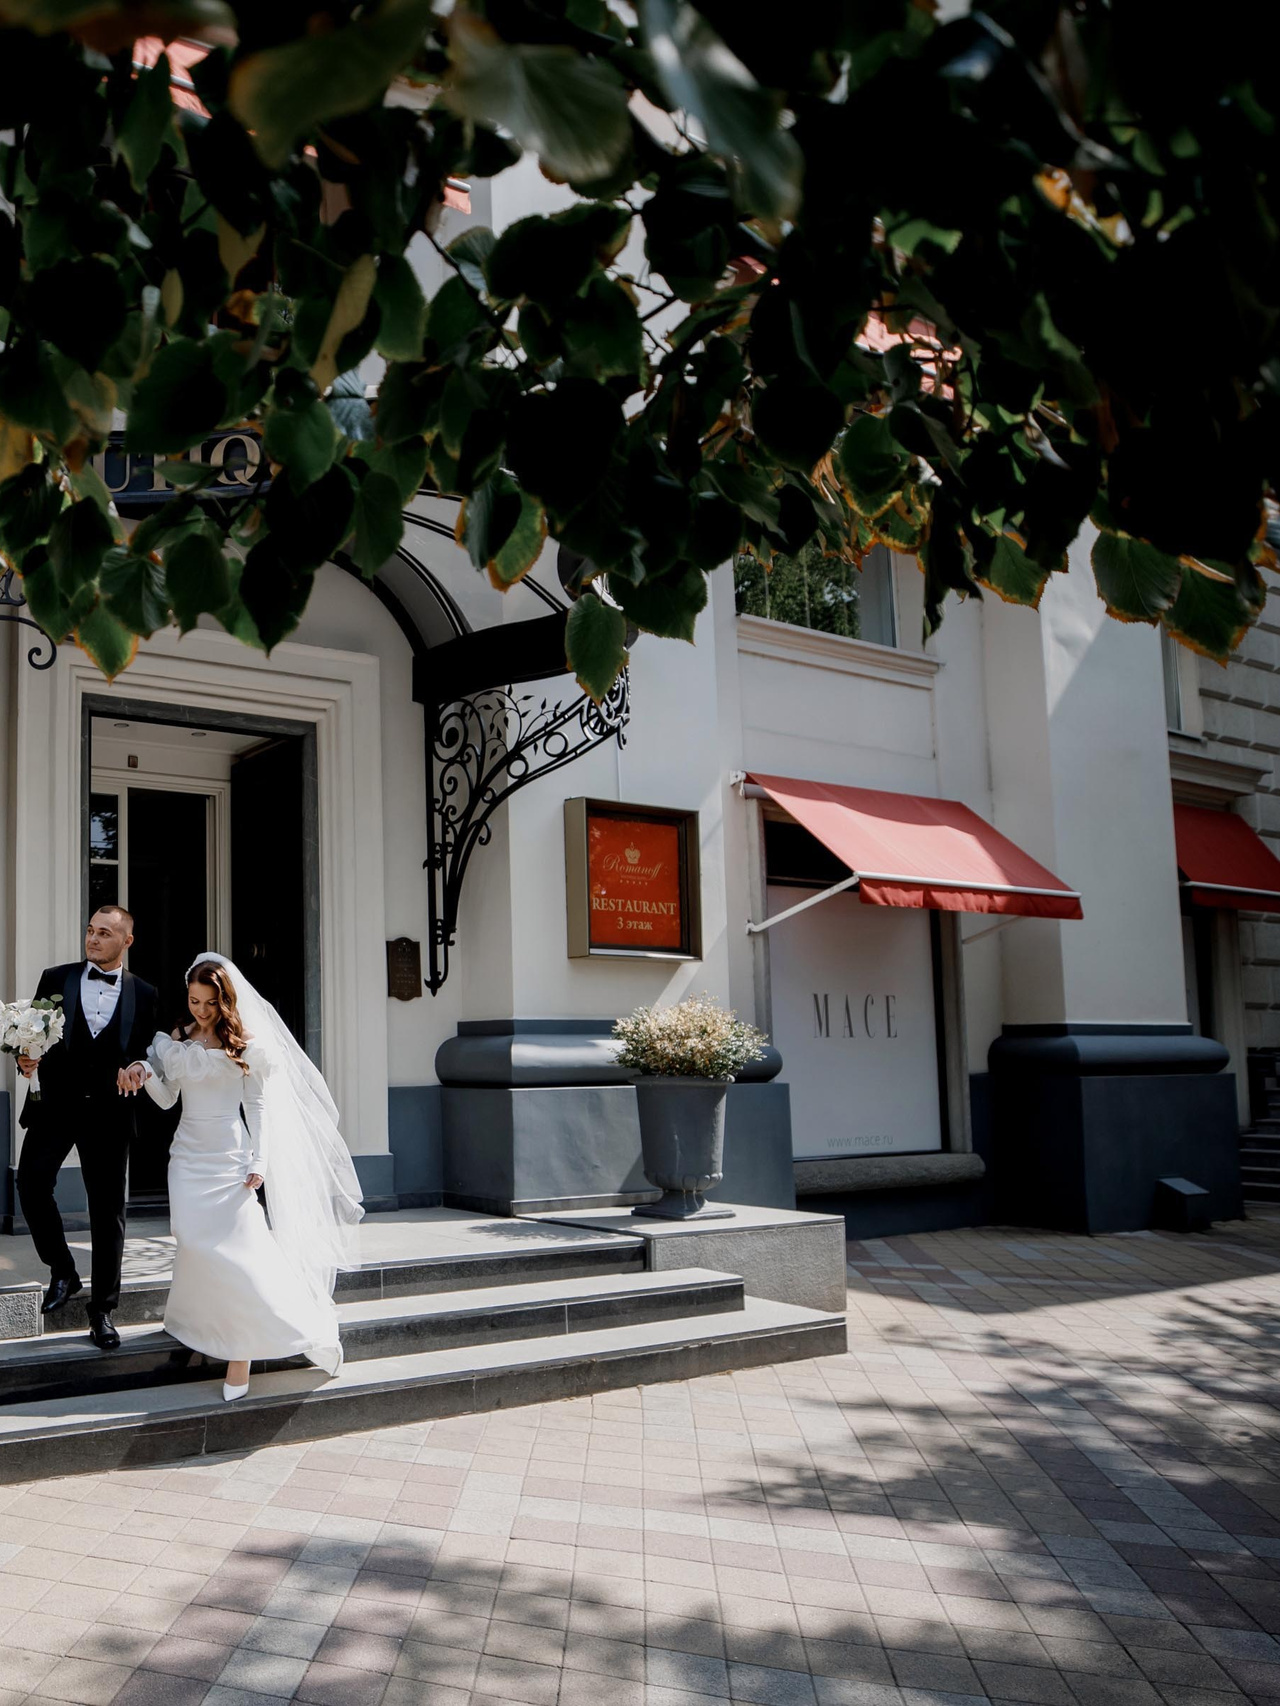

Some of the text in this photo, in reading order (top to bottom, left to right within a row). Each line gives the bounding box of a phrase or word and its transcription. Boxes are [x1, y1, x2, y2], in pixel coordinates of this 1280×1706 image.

[603, 854, 663, 880] Romanoff
[592, 898, 676, 915] RESTAURANT
[617, 917, 652, 930] 3 этаж
[813, 993, 898, 1038] MACE
[827, 1135, 893, 1148] www.mace.ru
